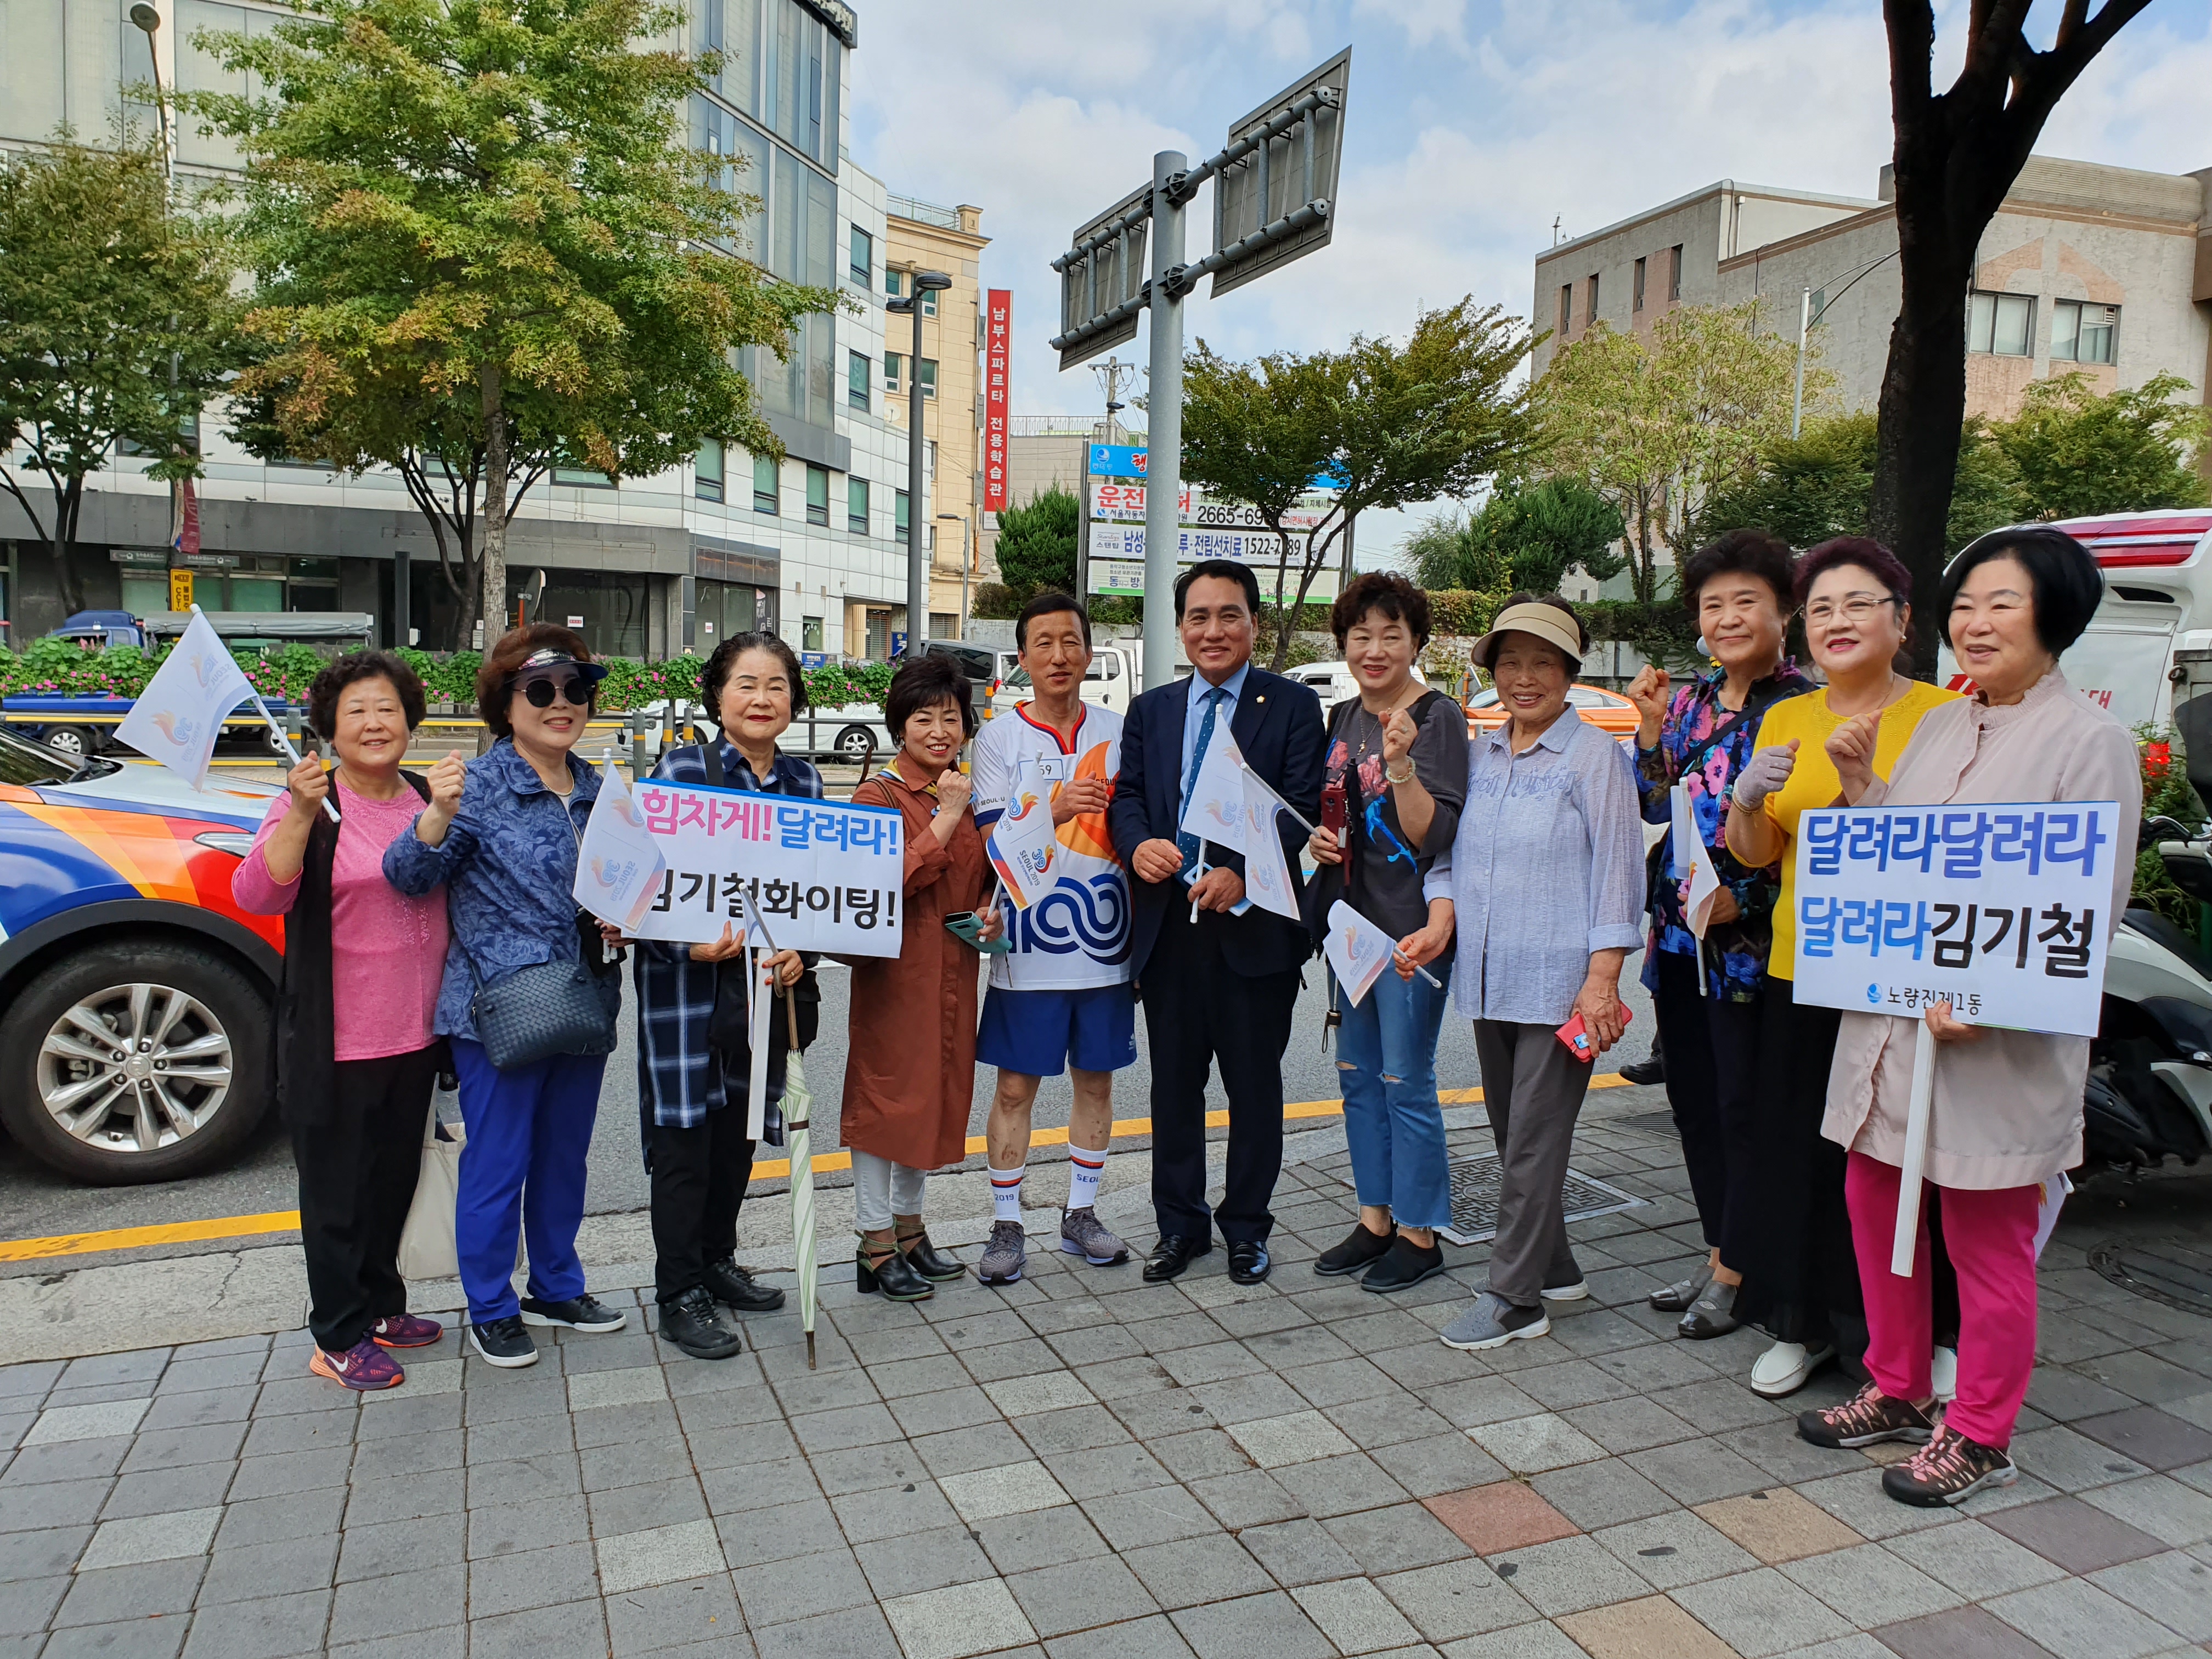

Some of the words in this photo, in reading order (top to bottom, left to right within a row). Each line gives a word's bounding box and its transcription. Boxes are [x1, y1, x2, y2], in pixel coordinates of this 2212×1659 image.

[991, 306, 1006, 404] 남부스파르타
[989, 417, 1003, 497] 전용학습관
[1097, 486, 1144, 510] 운전
[1110, 509, 1146, 520] 서울자동차
[1124, 530, 1146, 554] 남성
[1177, 534, 1242, 558] 루·전립선치료
[1244, 537, 1301, 556] 1522-789
[641, 788, 772, 842] 힘차게!
[777, 806, 898, 856] 달려라!
[1807, 811, 2106, 878] 달려라달려라
[1019, 849, 1034, 873] SEOUL
[1030, 872, 1041, 886] 2019
[1801, 896, 2095, 979] 달려라김기철
[994, 1193, 1015, 1201] 2019
